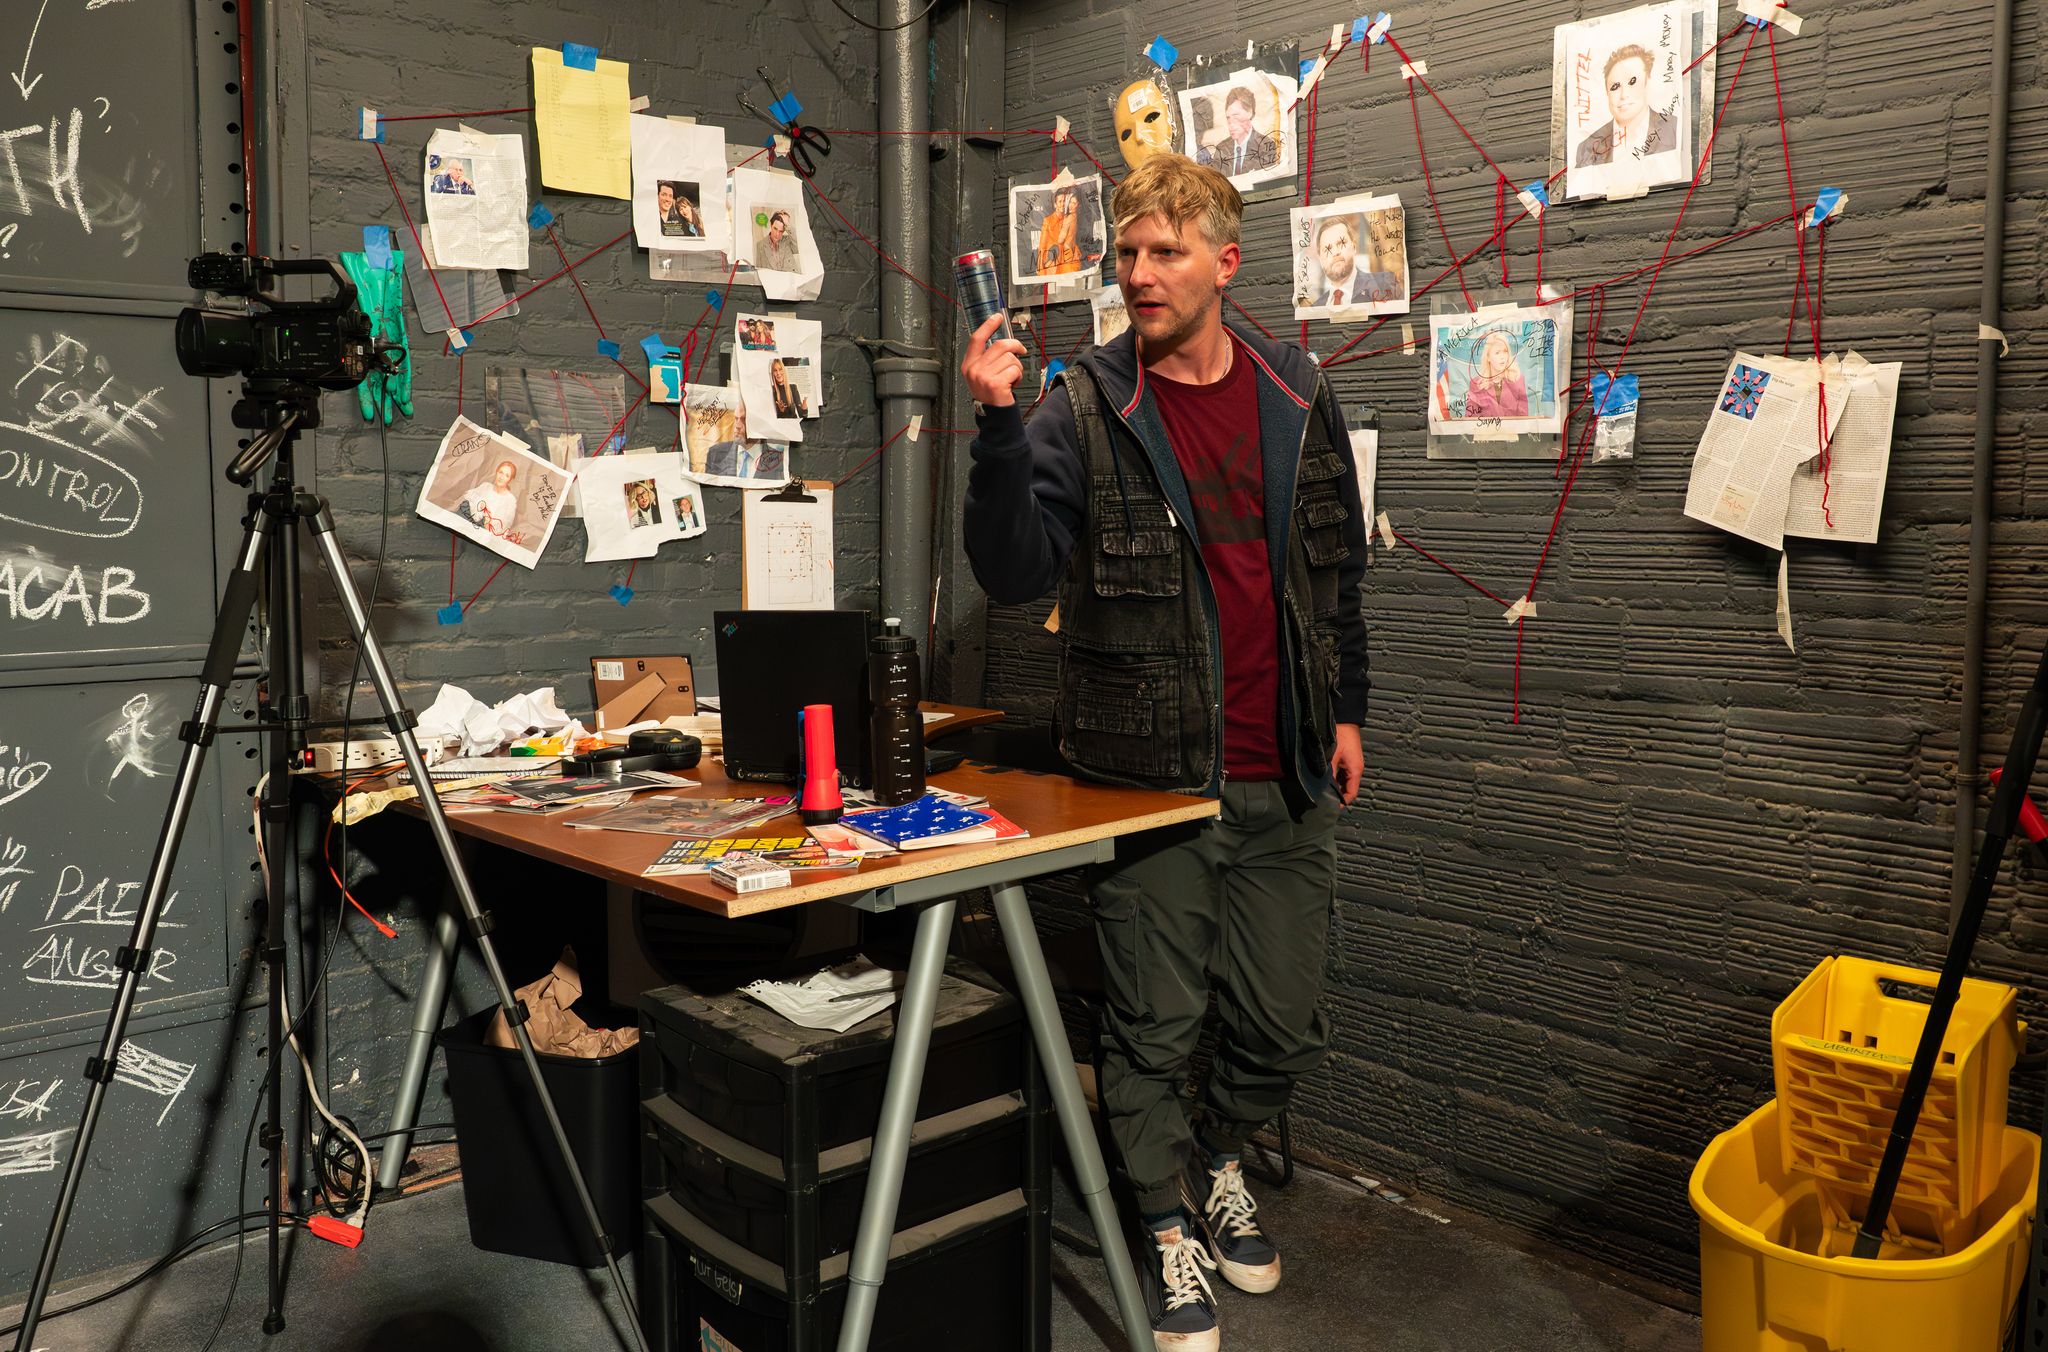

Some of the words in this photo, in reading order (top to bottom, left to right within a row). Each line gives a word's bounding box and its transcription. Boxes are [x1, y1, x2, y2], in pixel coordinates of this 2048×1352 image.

[1574, 48, 1592, 128] TWITTER
[1438, 317, 1479, 360] AMERICA
[1529, 347, 1553, 358] LIES
